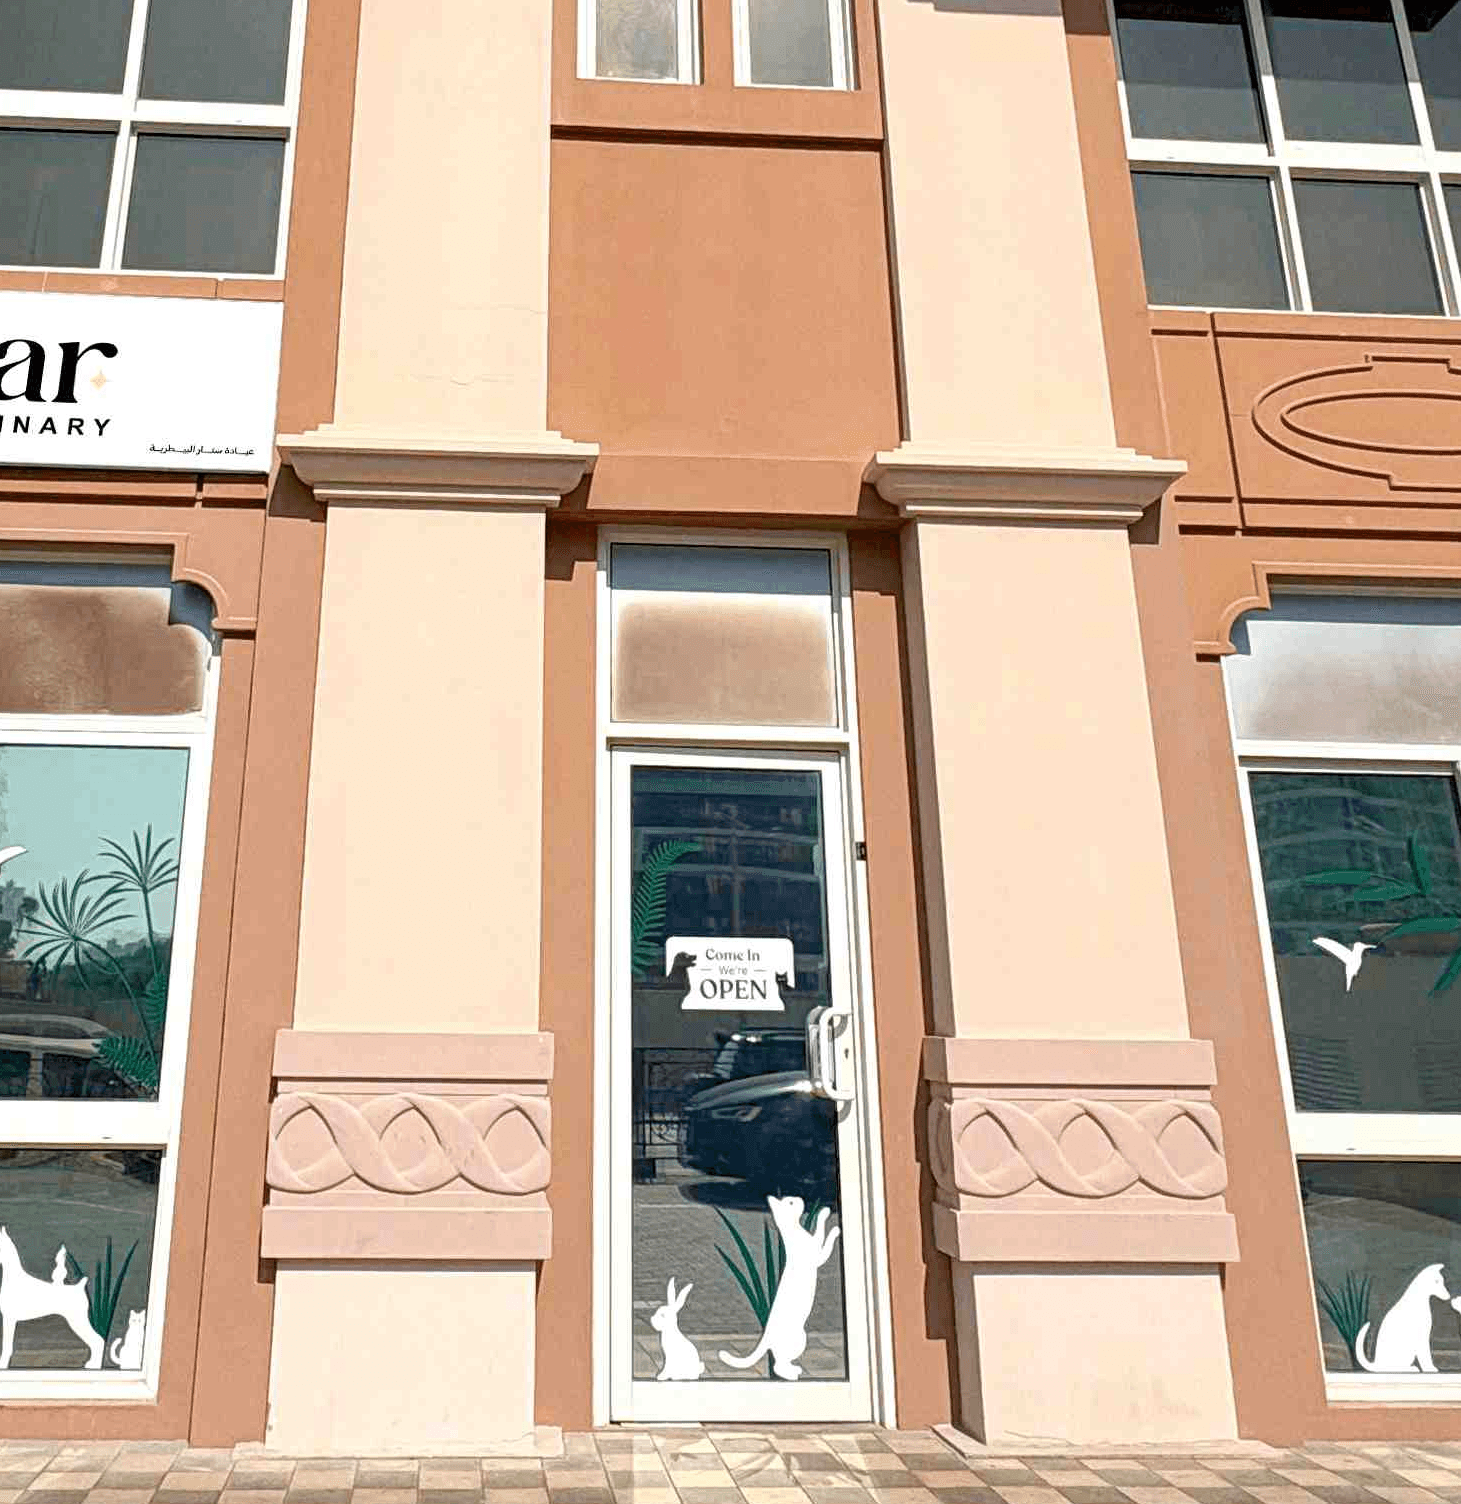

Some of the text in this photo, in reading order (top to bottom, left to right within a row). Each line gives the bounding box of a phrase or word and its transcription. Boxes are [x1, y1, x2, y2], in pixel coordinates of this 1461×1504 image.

[705, 948, 760, 961] Come In
[699, 978, 767, 1000] OPEN
